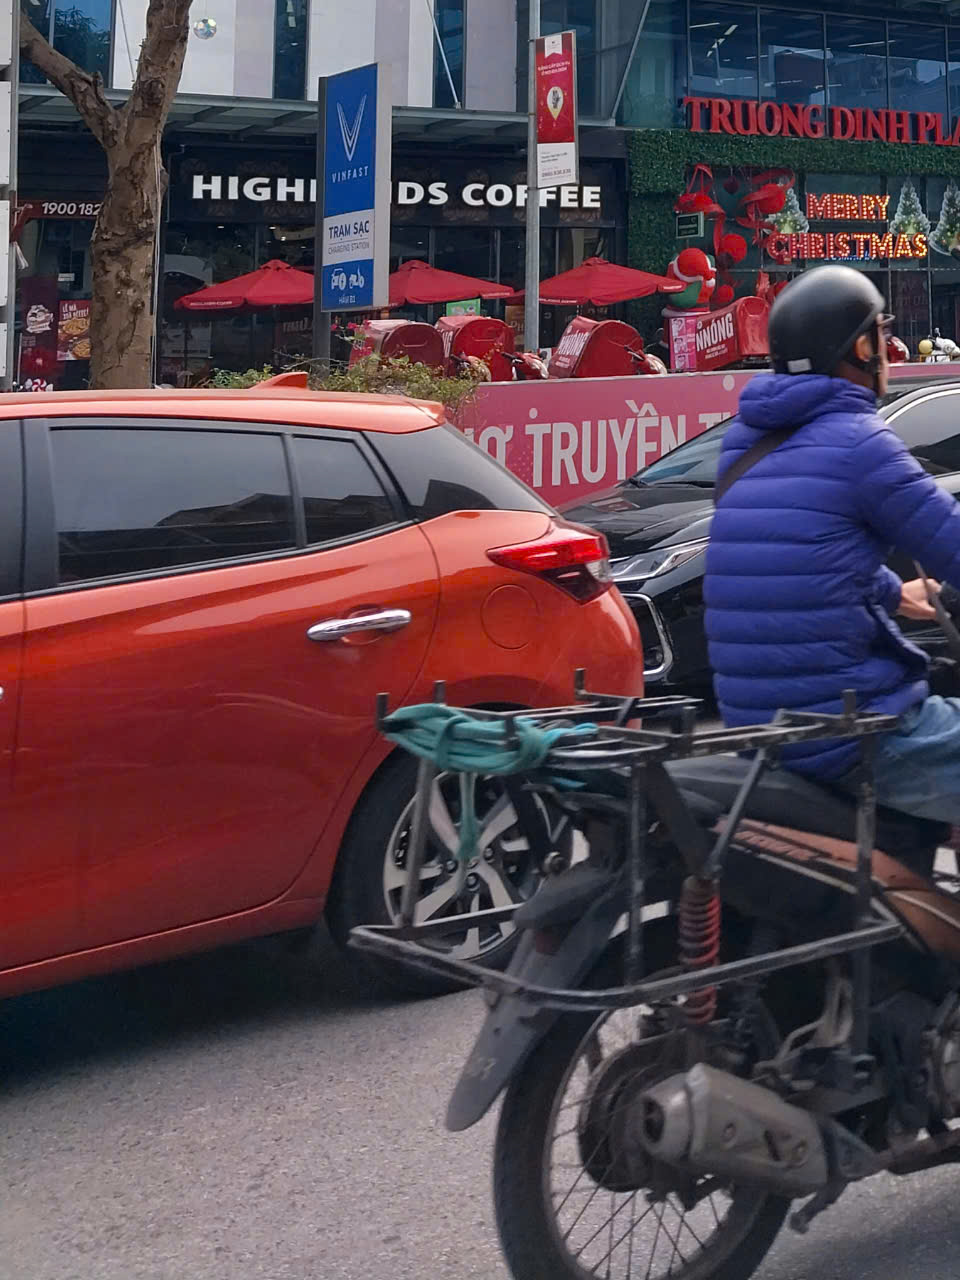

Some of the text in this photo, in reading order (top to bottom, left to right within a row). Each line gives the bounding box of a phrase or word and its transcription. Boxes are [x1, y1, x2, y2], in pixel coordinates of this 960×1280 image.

[684, 96, 825, 139] TRUONG
[831, 106, 911, 144] DINH
[332, 166, 369, 183] VINFAST
[462, 181, 600, 208] COFFEE
[806, 193, 889, 220] MERRY
[43, 202, 76, 215] 1900
[329, 220, 370, 241] TRẠM SẠC
[351, 239, 370, 252] STATION
[767, 231, 929, 260] CHRISTMAS
